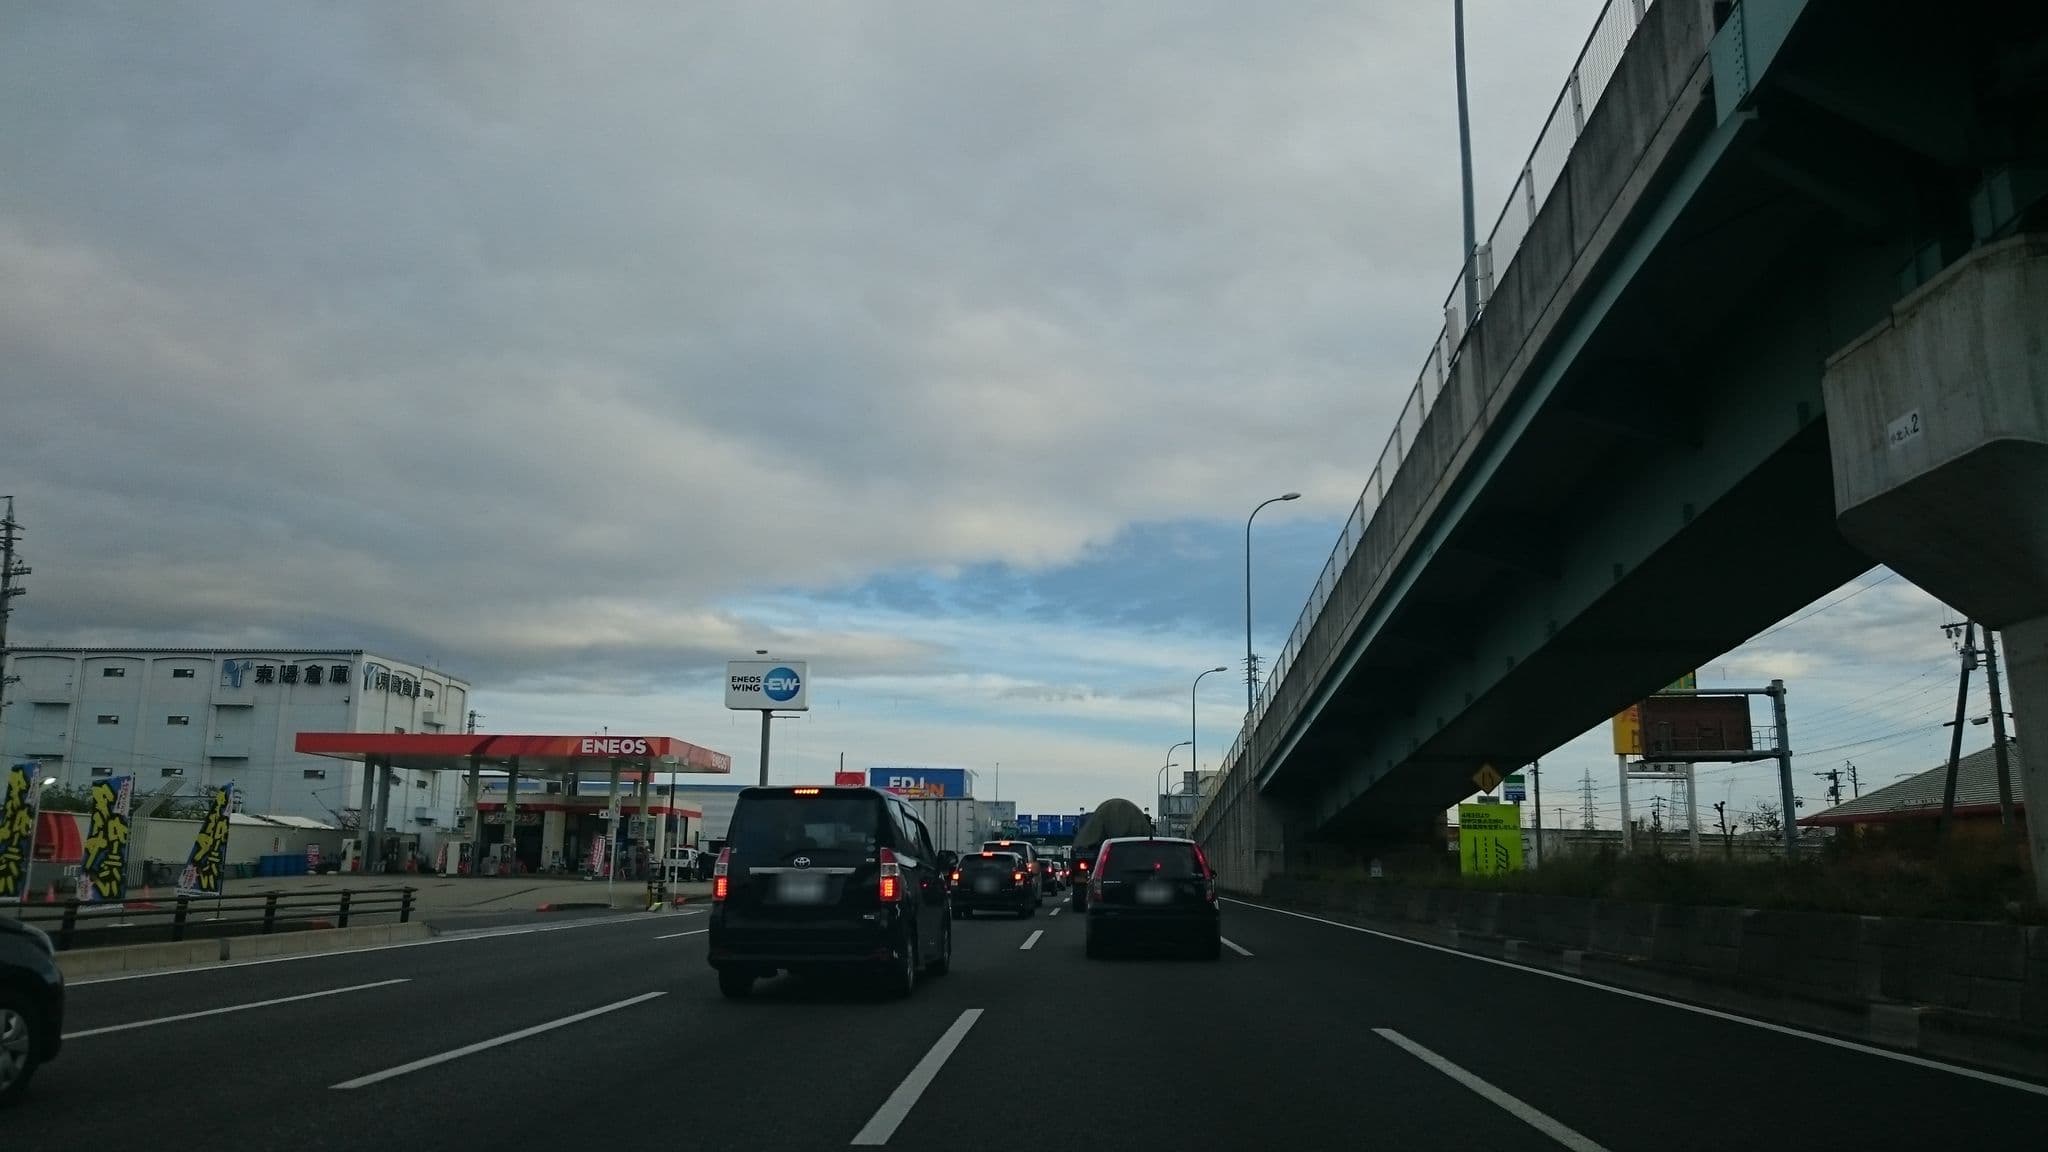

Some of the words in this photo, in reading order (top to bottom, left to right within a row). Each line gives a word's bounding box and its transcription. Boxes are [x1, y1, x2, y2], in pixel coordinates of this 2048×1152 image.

[254, 664, 351, 685] 東陽倉庫
[731, 675, 761, 683] ENEOS
[731, 684, 761, 692] WING
[768, 678, 798, 691] EW
[581, 738, 647, 755] ENEOS
